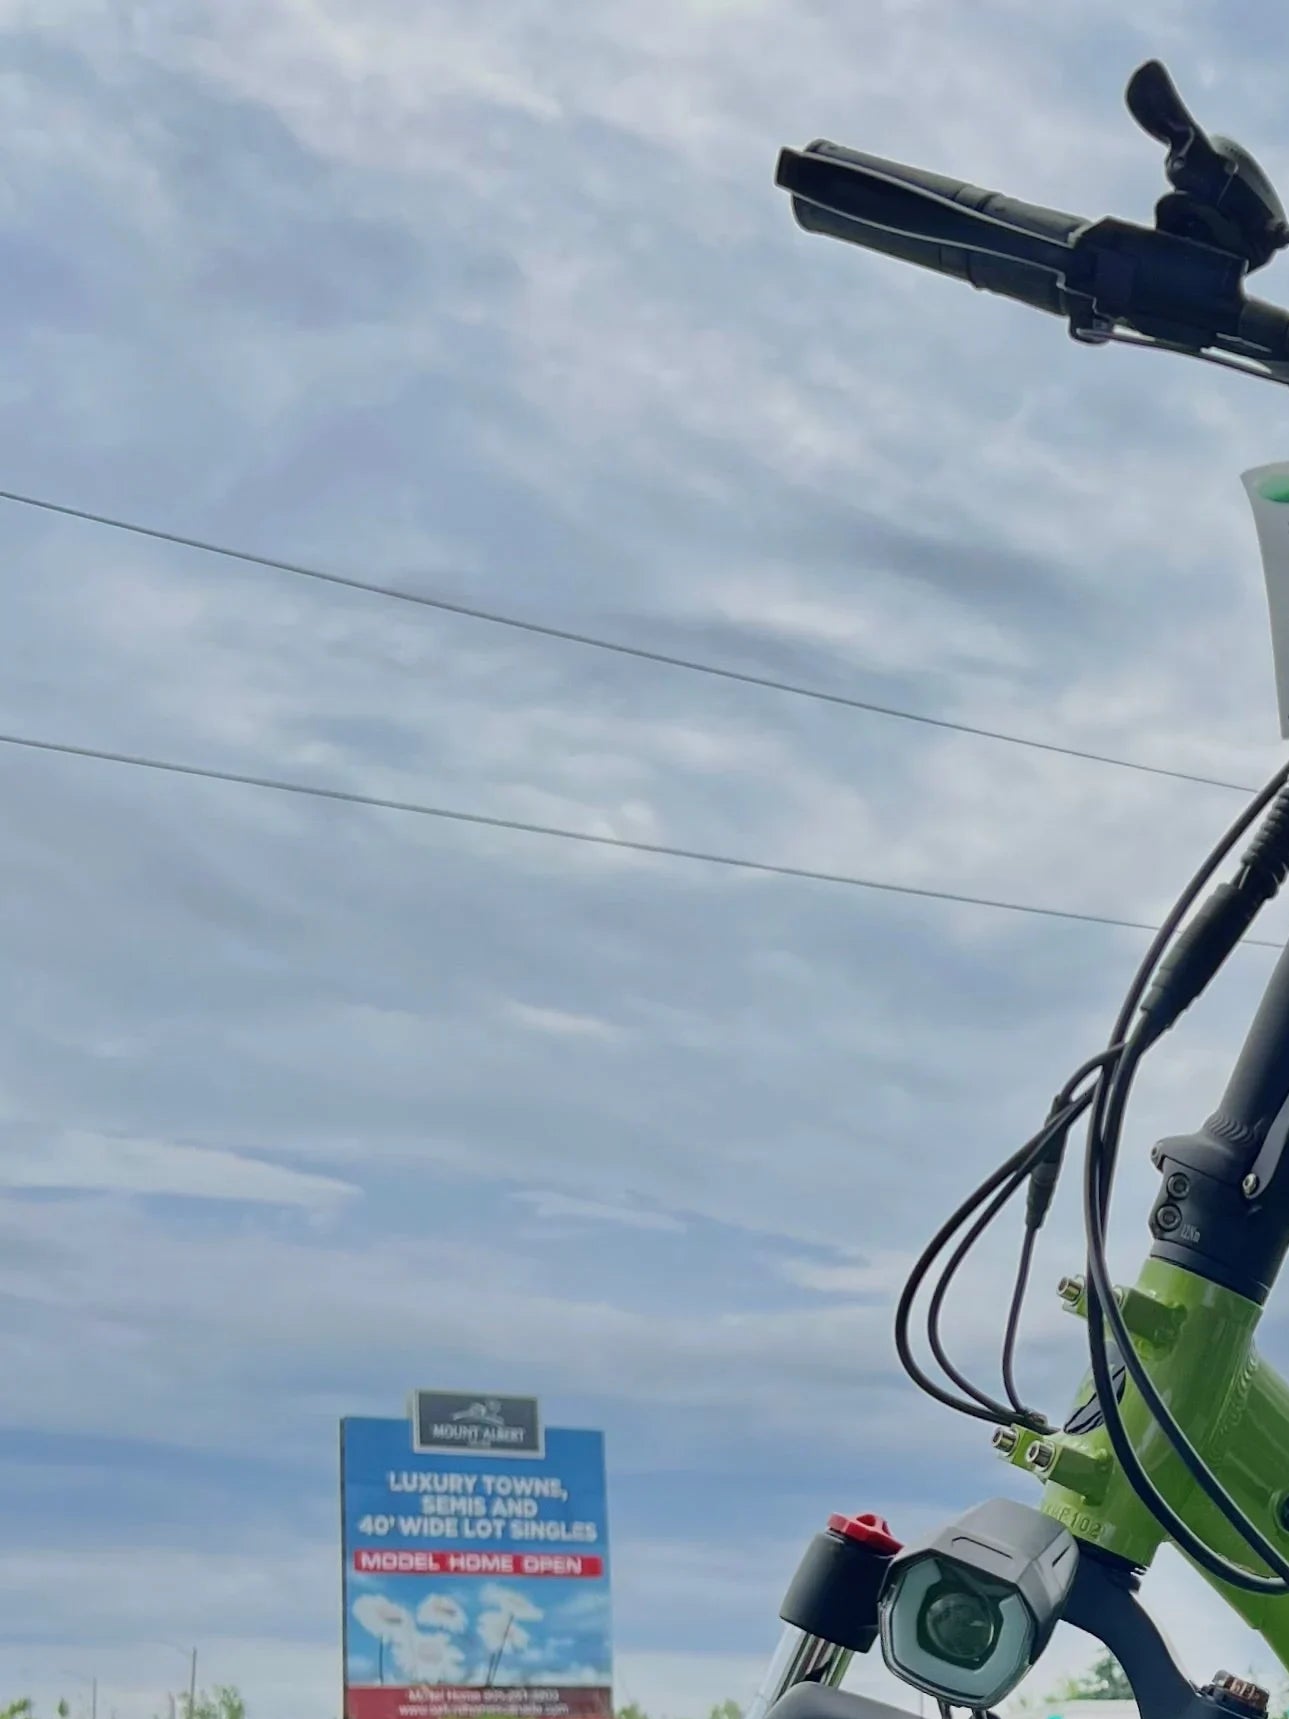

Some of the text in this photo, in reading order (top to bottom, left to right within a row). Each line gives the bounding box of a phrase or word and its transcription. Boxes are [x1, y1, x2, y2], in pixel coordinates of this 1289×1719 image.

[432, 1424, 478, 1440] MOUNT
[389, 1472, 568, 1501] LUXURY TOWNS,
[421, 1495, 538, 1518] SEMIS AND
[400, 1517, 458, 1538] WIDE
[464, 1519, 505, 1539] LOT
[510, 1521, 597, 1542] SINGLES
[361, 1552, 582, 1574] MODEL HOME OPEN
